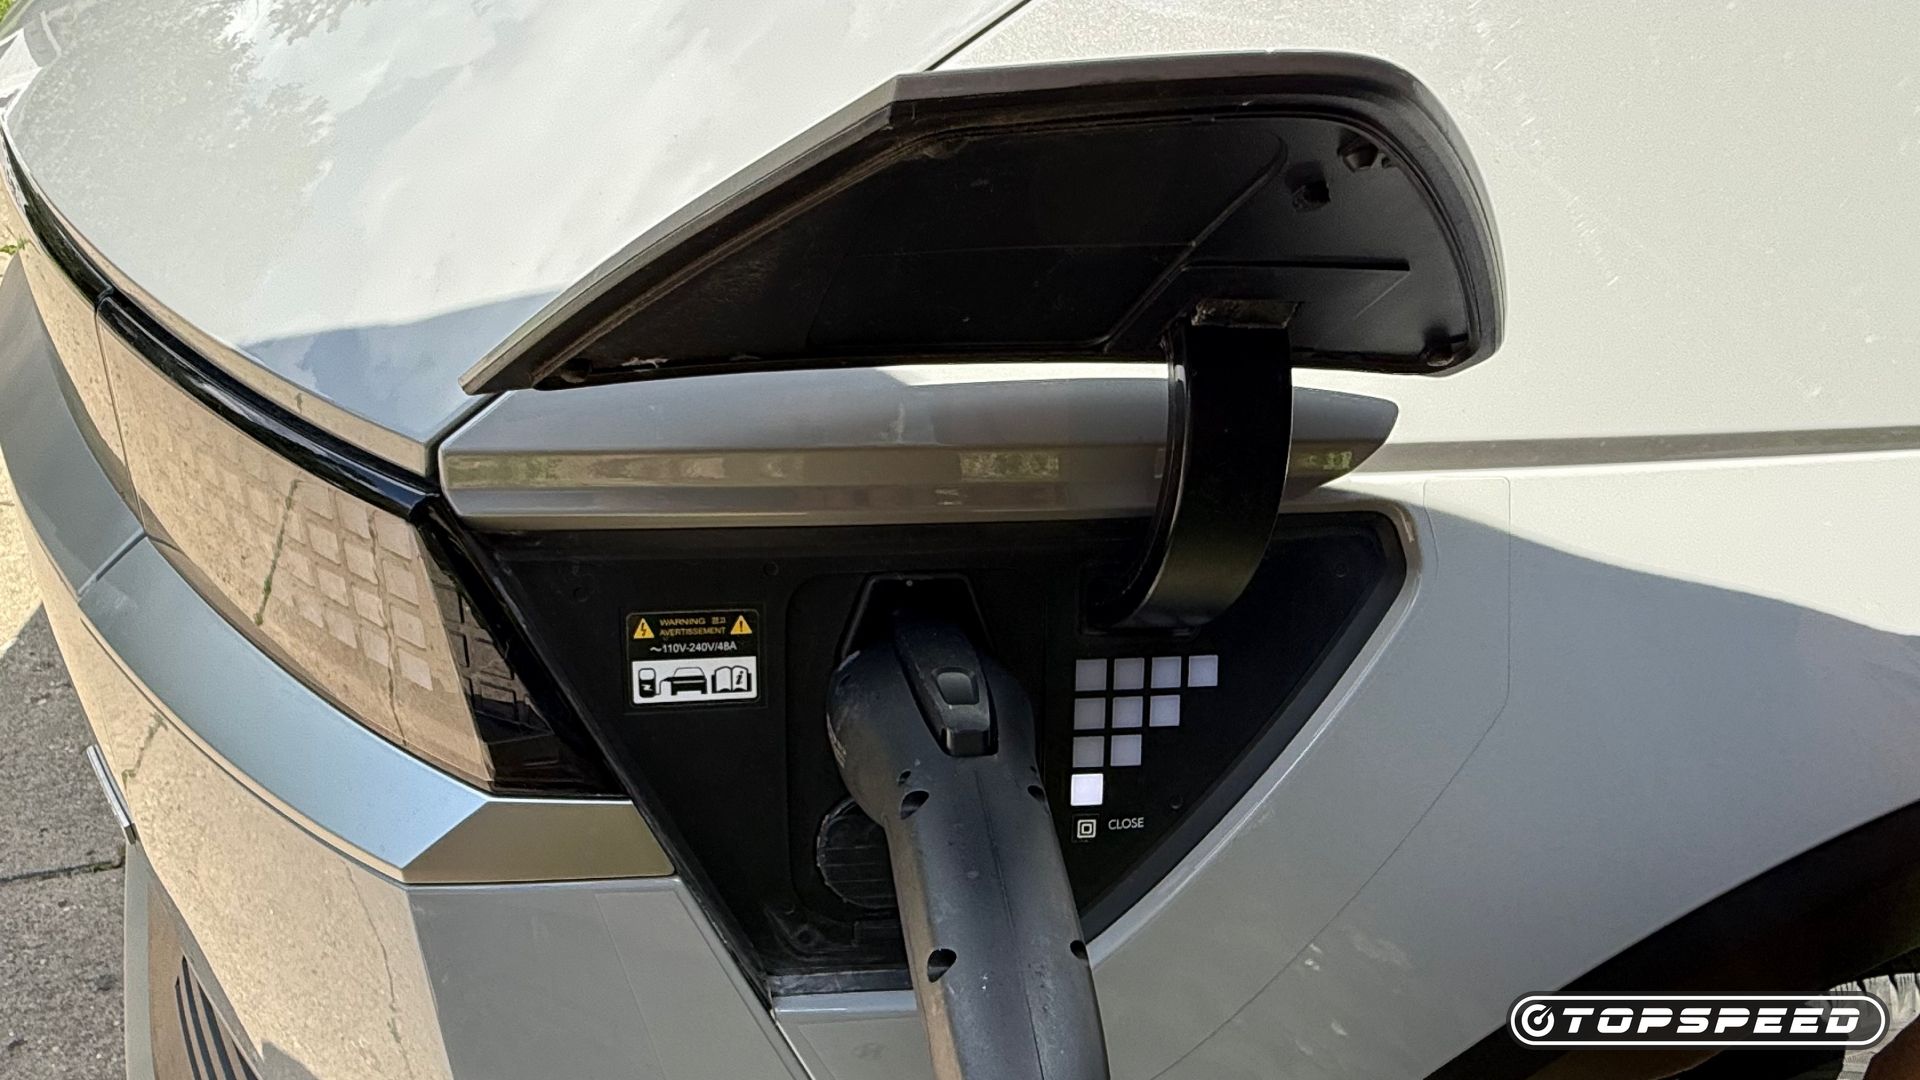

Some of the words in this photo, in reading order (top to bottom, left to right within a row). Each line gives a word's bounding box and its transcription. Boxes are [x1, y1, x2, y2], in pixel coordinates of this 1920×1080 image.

[659, 617, 706, 626] WARNING
[659, 627, 726, 636] AVERTISSEMENT
[1108, 817, 1145, 830] CLOSE
